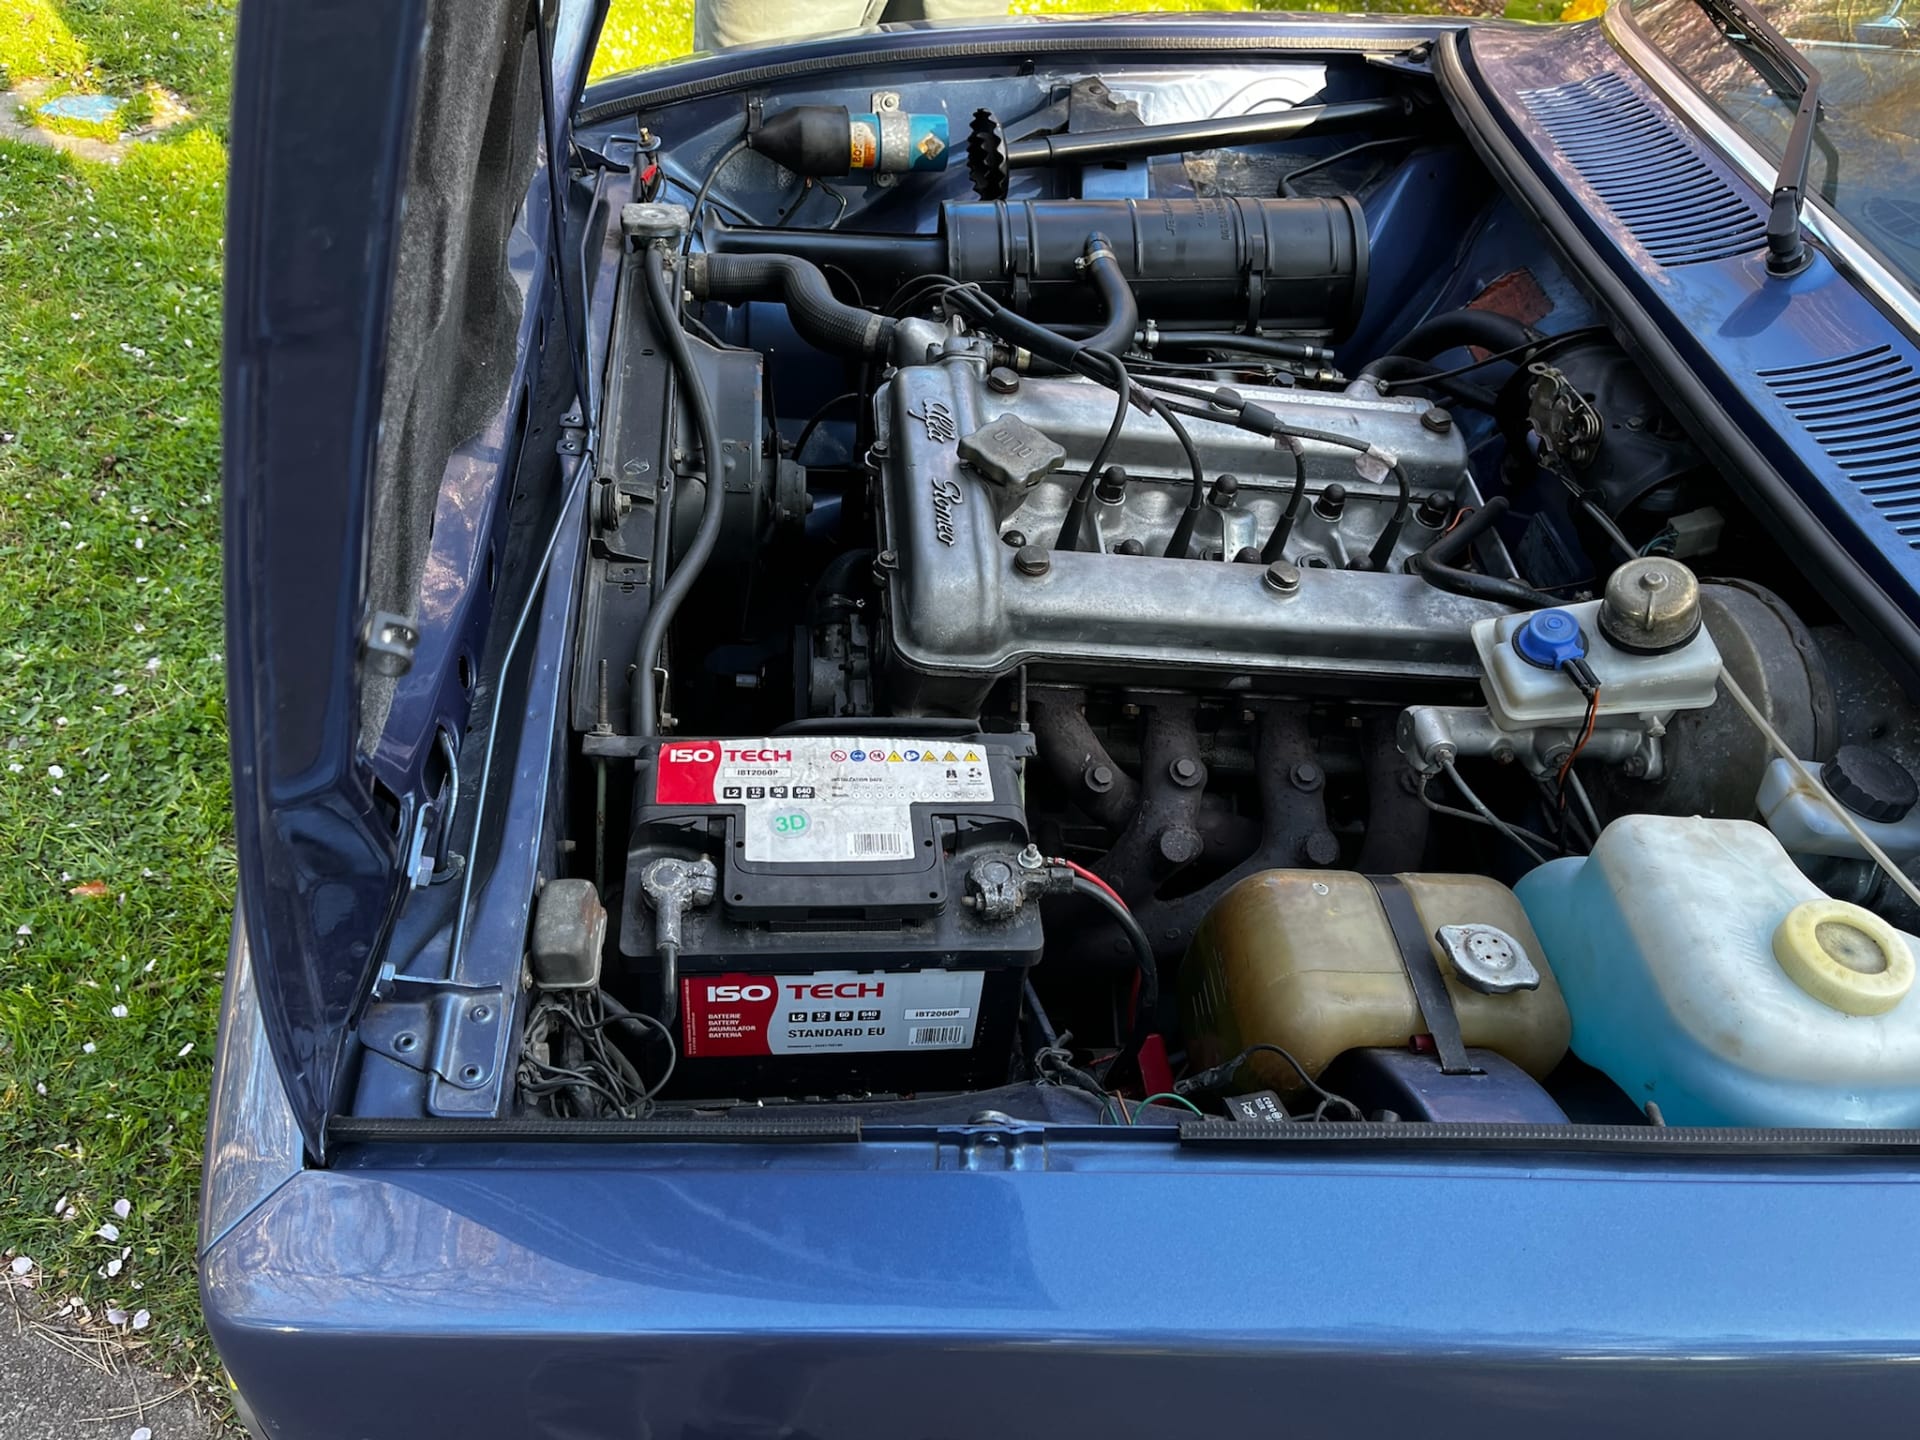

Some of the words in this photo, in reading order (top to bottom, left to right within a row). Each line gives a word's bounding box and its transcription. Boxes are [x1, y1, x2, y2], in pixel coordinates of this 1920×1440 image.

[994, 431, 1033, 458] OLIO
[931, 477, 963, 547] Romeo
[669, 749, 715, 763] ISO
[724, 749, 792, 762] TECH
[726, 788, 740, 797] L2
[775, 814, 807, 832] 3D
[707, 985, 771, 1002] ISO
[786, 982, 885, 1000] TECH
[788, 1027, 863, 1038] STANDARD
[868, 1027, 885, 1036] EU
